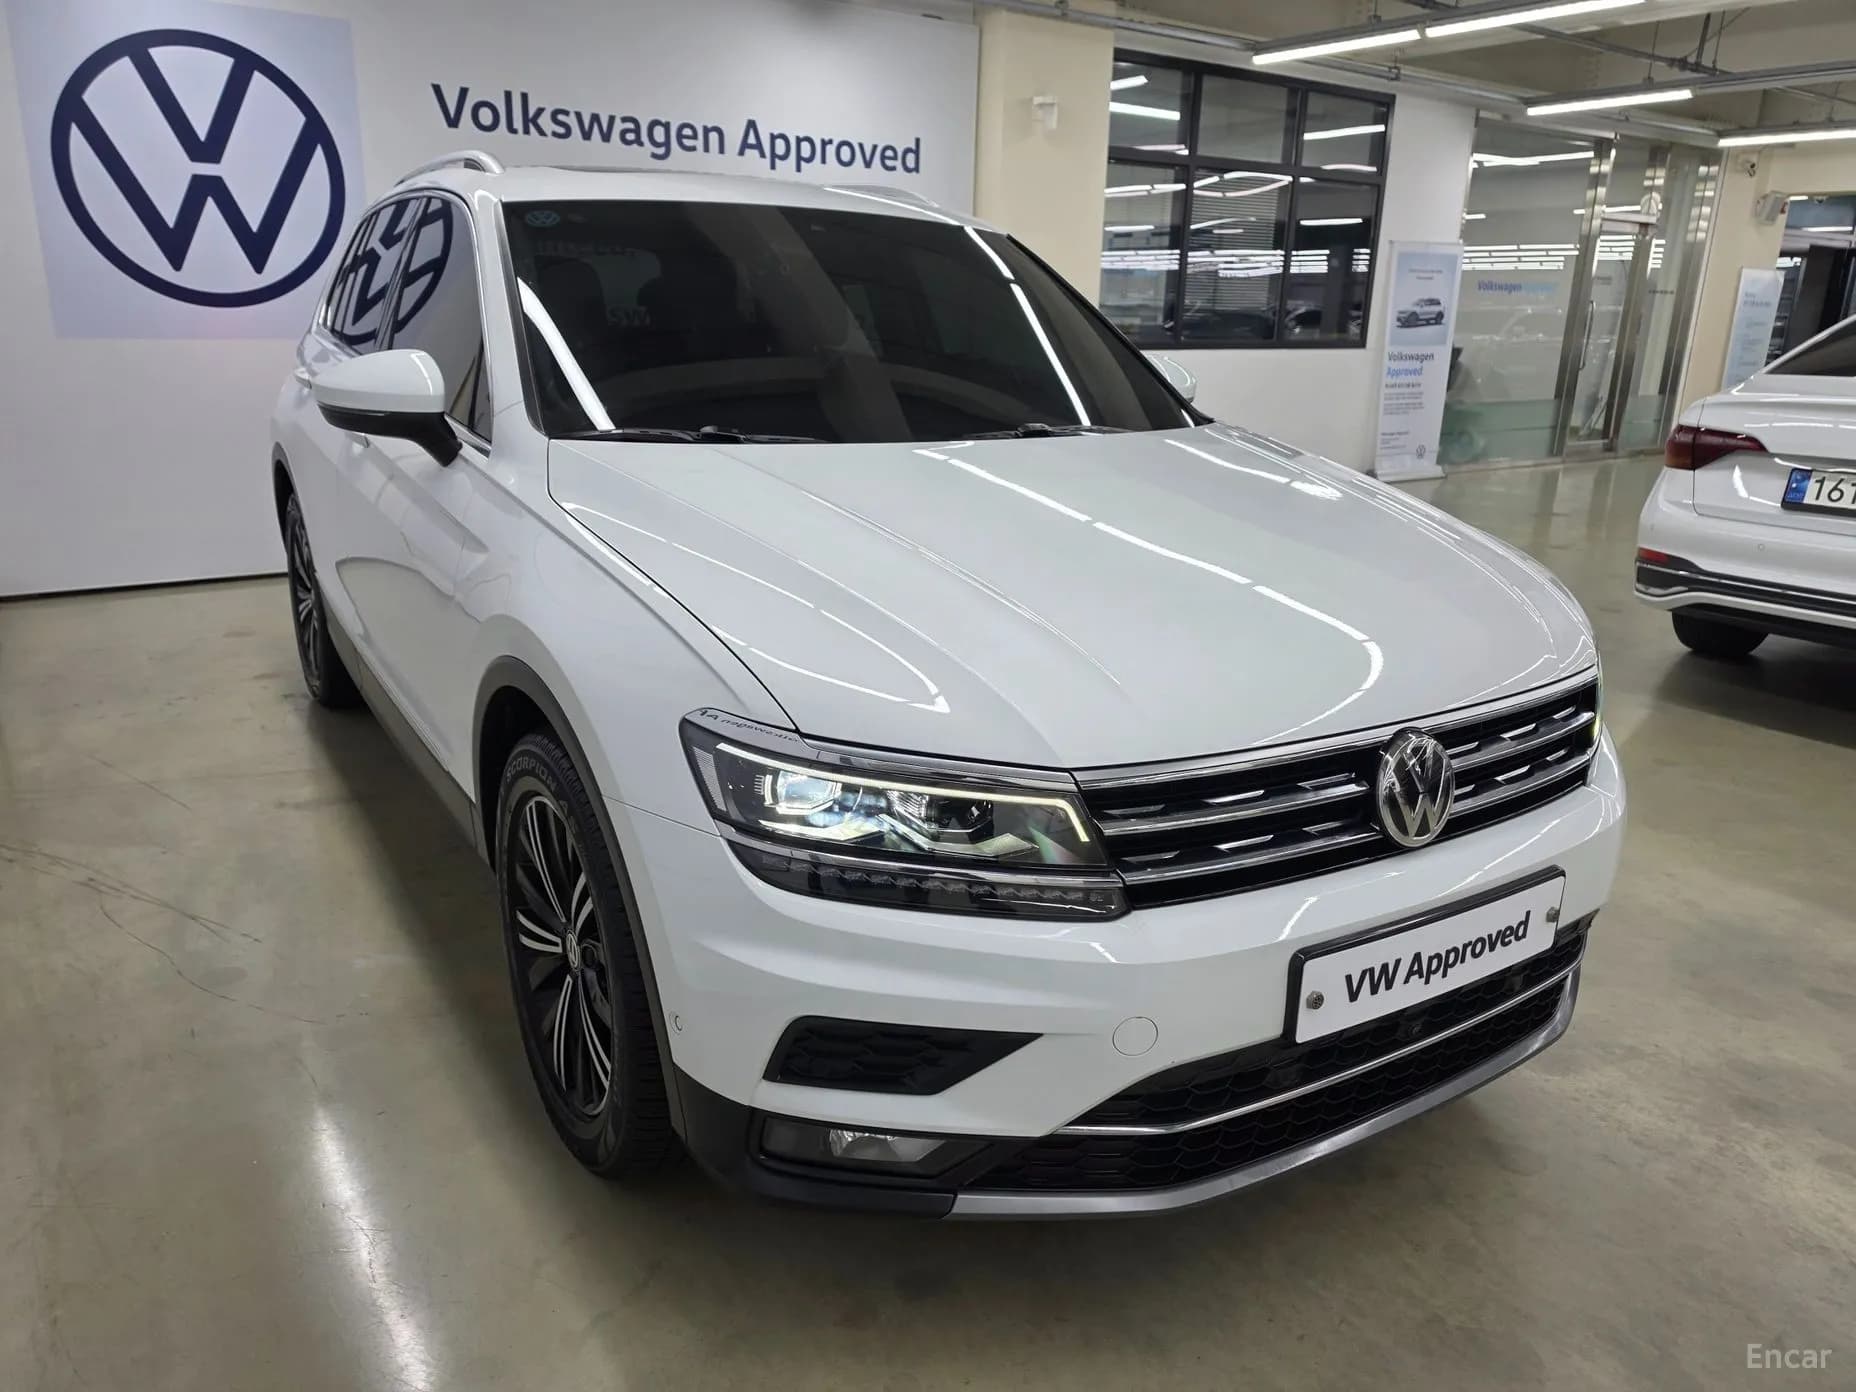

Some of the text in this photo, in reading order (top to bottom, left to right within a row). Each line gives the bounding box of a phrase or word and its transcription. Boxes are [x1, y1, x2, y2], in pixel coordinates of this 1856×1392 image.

[431, 83, 921, 174] Volkswagen Approved
[1387, 366, 1423, 378] Approved
[1388, 352, 1434, 364] Volkswagen
[1345, 910, 1531, 1003] VW Approved
